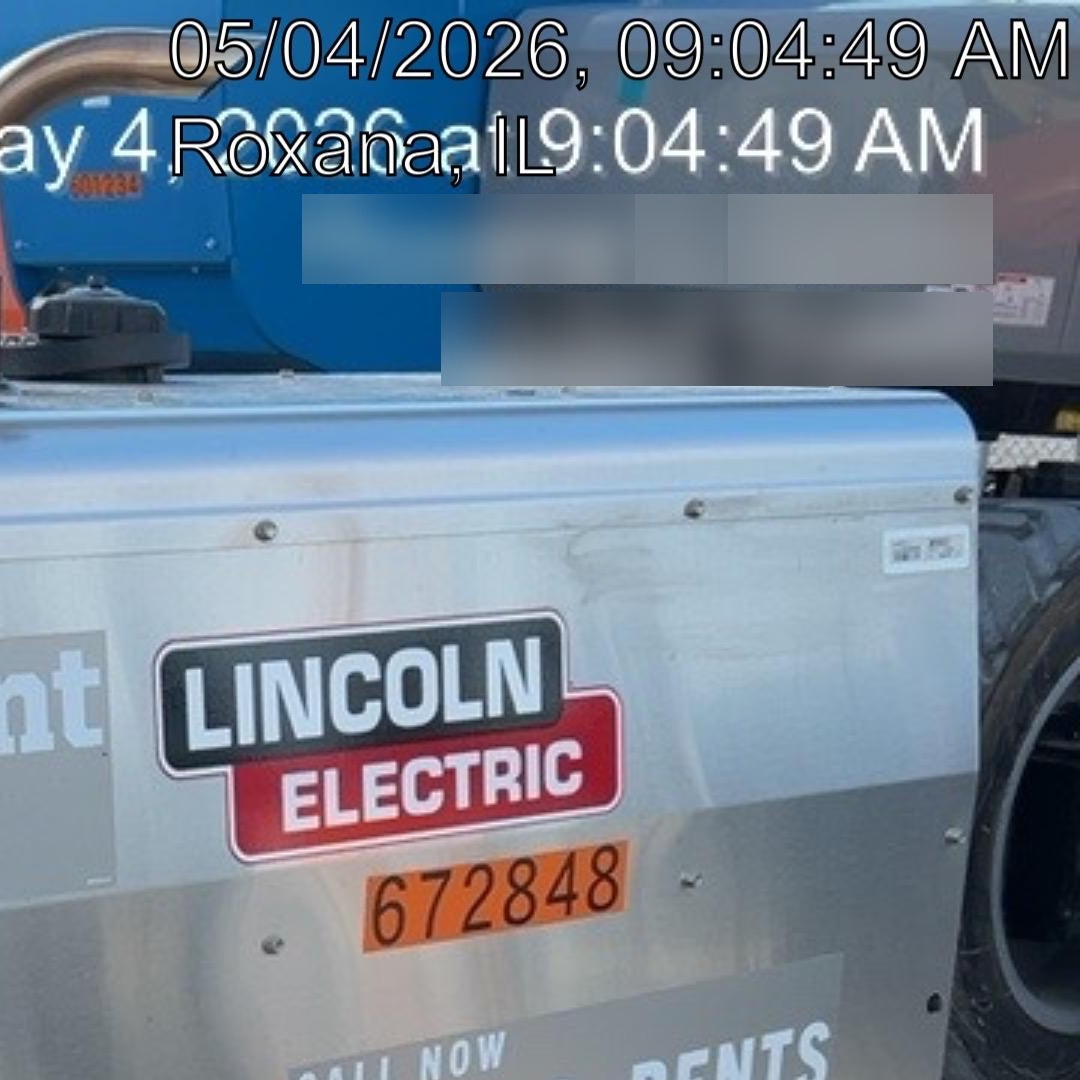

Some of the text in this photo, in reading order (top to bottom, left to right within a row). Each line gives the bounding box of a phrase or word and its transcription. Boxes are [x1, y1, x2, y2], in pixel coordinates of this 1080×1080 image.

[185, 637, 542, 752] LINCOLN
[281, 738, 583, 833] ELECTRIC
[371, 843, 620, 947] 672848
